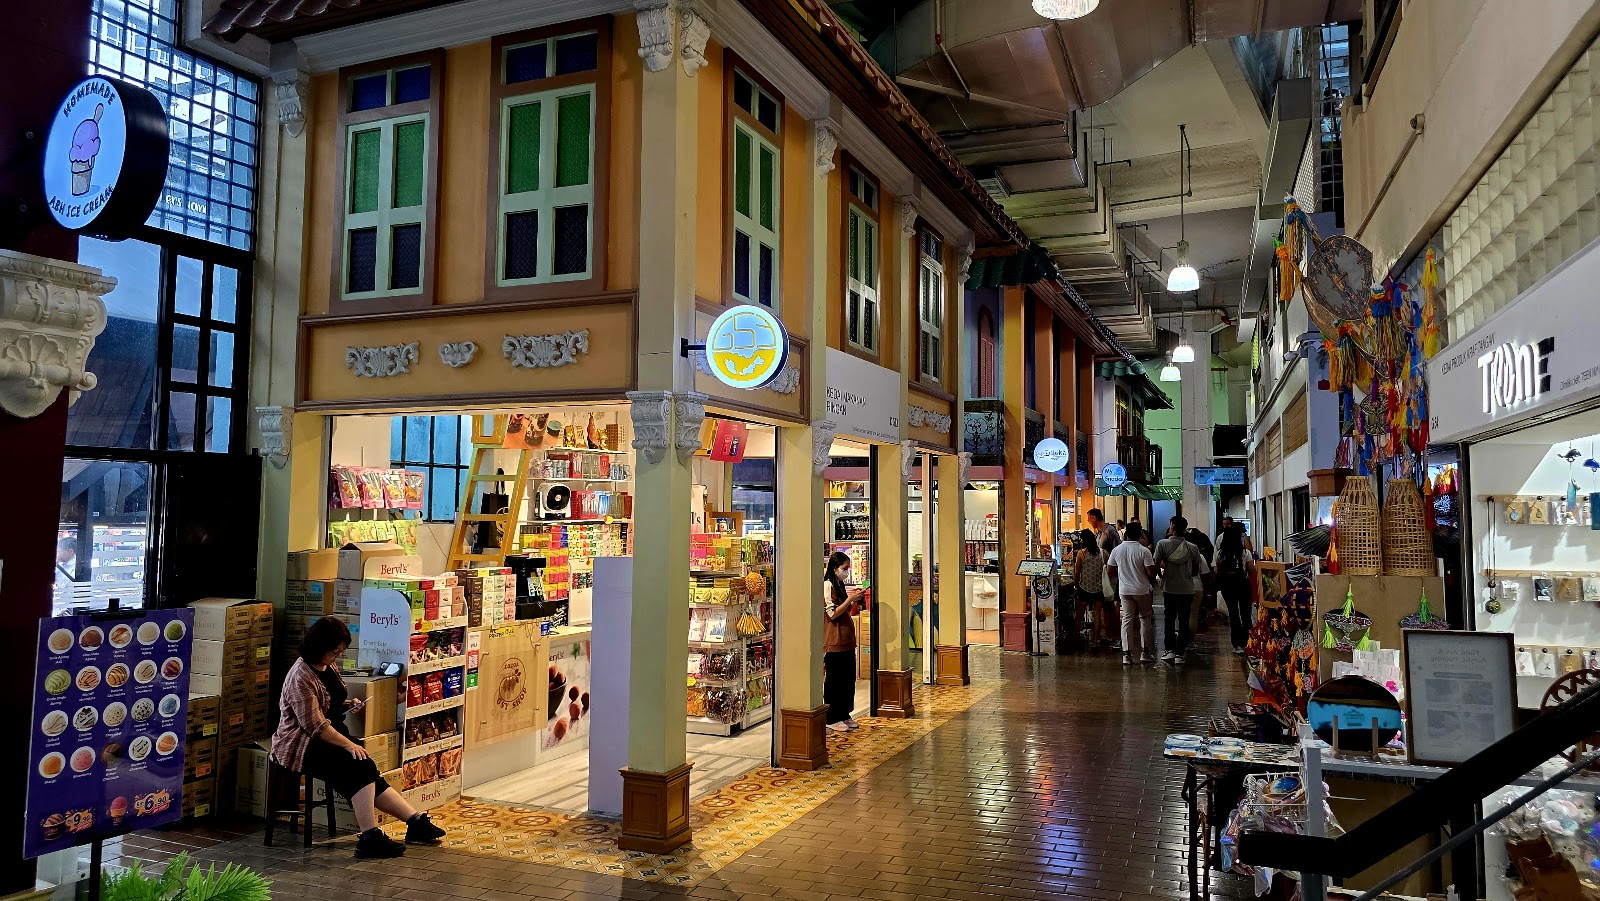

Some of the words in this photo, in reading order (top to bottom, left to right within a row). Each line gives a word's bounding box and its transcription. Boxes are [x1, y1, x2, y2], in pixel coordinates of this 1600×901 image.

[63, 81, 116, 118] HOMEMADE
[66, 205, 81, 218] ICE
[83, 184, 114, 215] CREAM
[380, 563, 408, 576] Beryl's
[370, 613, 399, 630] Beryl's
[549, 651, 565, 664] eryl's
[512, 687, 527, 709] SHOP
[420, 789, 441, 803] Beryl's
